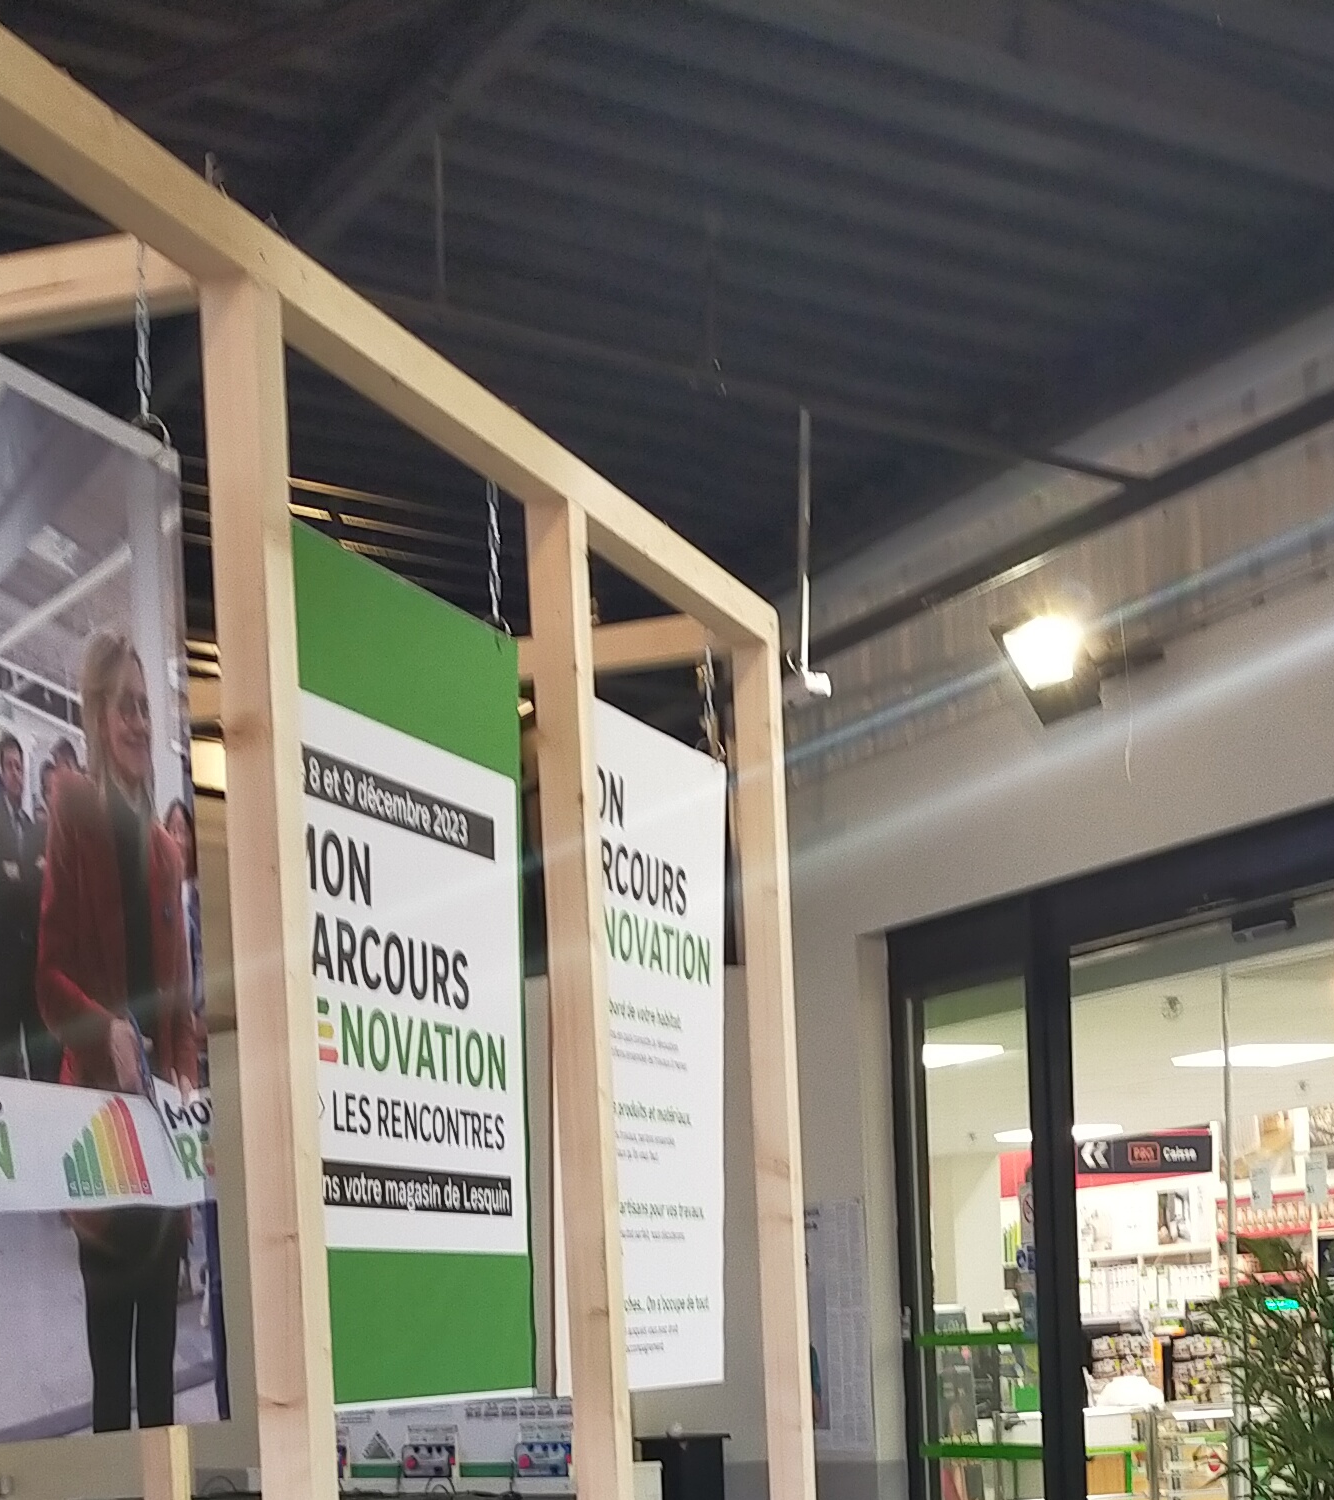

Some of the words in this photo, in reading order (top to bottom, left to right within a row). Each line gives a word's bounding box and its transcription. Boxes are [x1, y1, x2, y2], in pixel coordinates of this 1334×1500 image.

[309, 756, 321, 795] 8
[323, 765, 341, 801] et
[343, 770, 354, 805] 9
[357, 774, 432, 834] décembre
[433, 804, 469, 847] 2023
[601, 835, 688, 916] RCOURS
[312, 911, 469, 1010] ARCOURS
[333, 1090, 371, 1135] LES
[377, 1097, 505, 1150] RENCONTRES
[344, 1172, 381, 1202] votre
[385, 1176, 441, 1214] magasin
[443, 1177, 460, 1207] de
[463, 1180, 510, 1215] Lesquin
